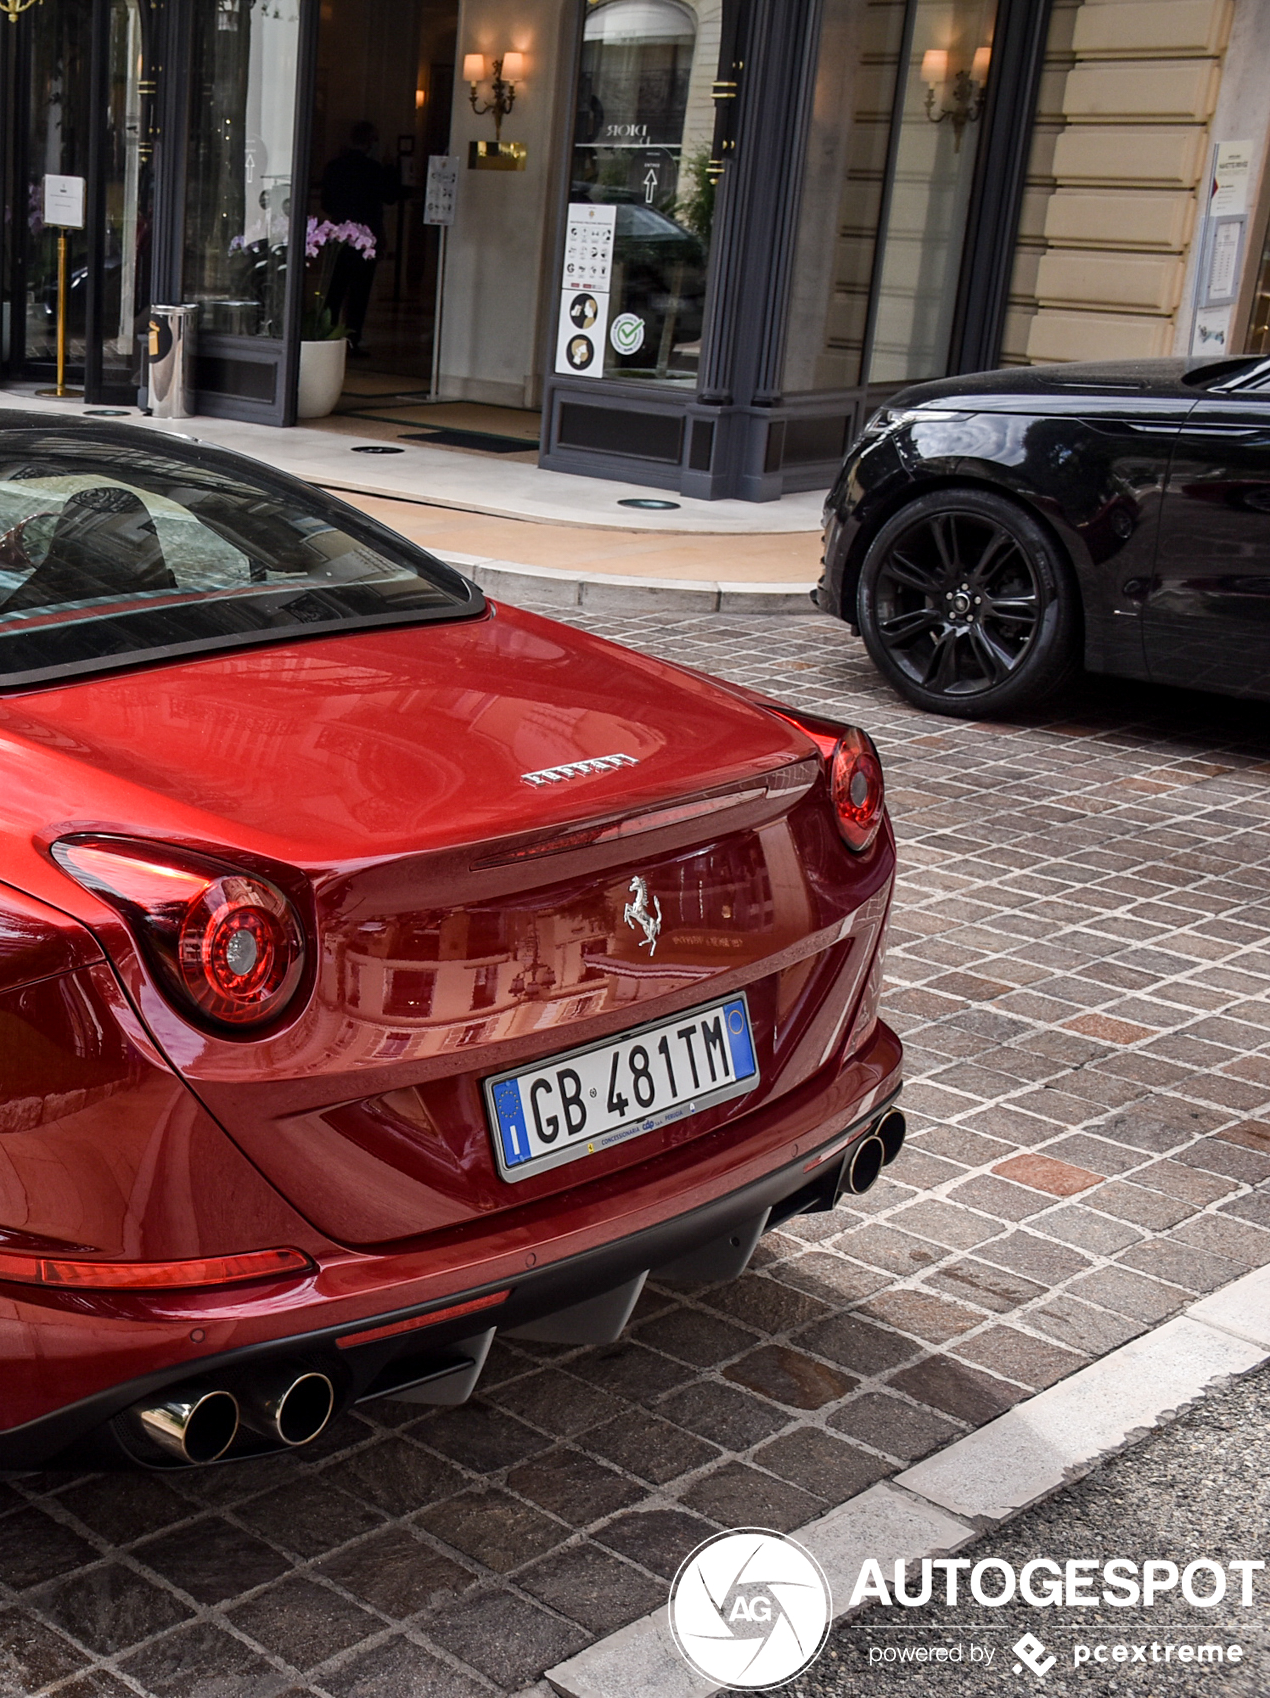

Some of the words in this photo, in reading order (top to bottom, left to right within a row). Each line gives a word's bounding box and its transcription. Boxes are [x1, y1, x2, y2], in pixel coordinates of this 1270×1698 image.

[521, 752, 640, 787] Ferrari
[530, 1068, 587, 1144] GB
[607, 1016, 730, 1117] 481TM
[602, 1126, 640, 1146] CONCESSIONARIA
[665, 1110, 683, 1121] PERUGIA
